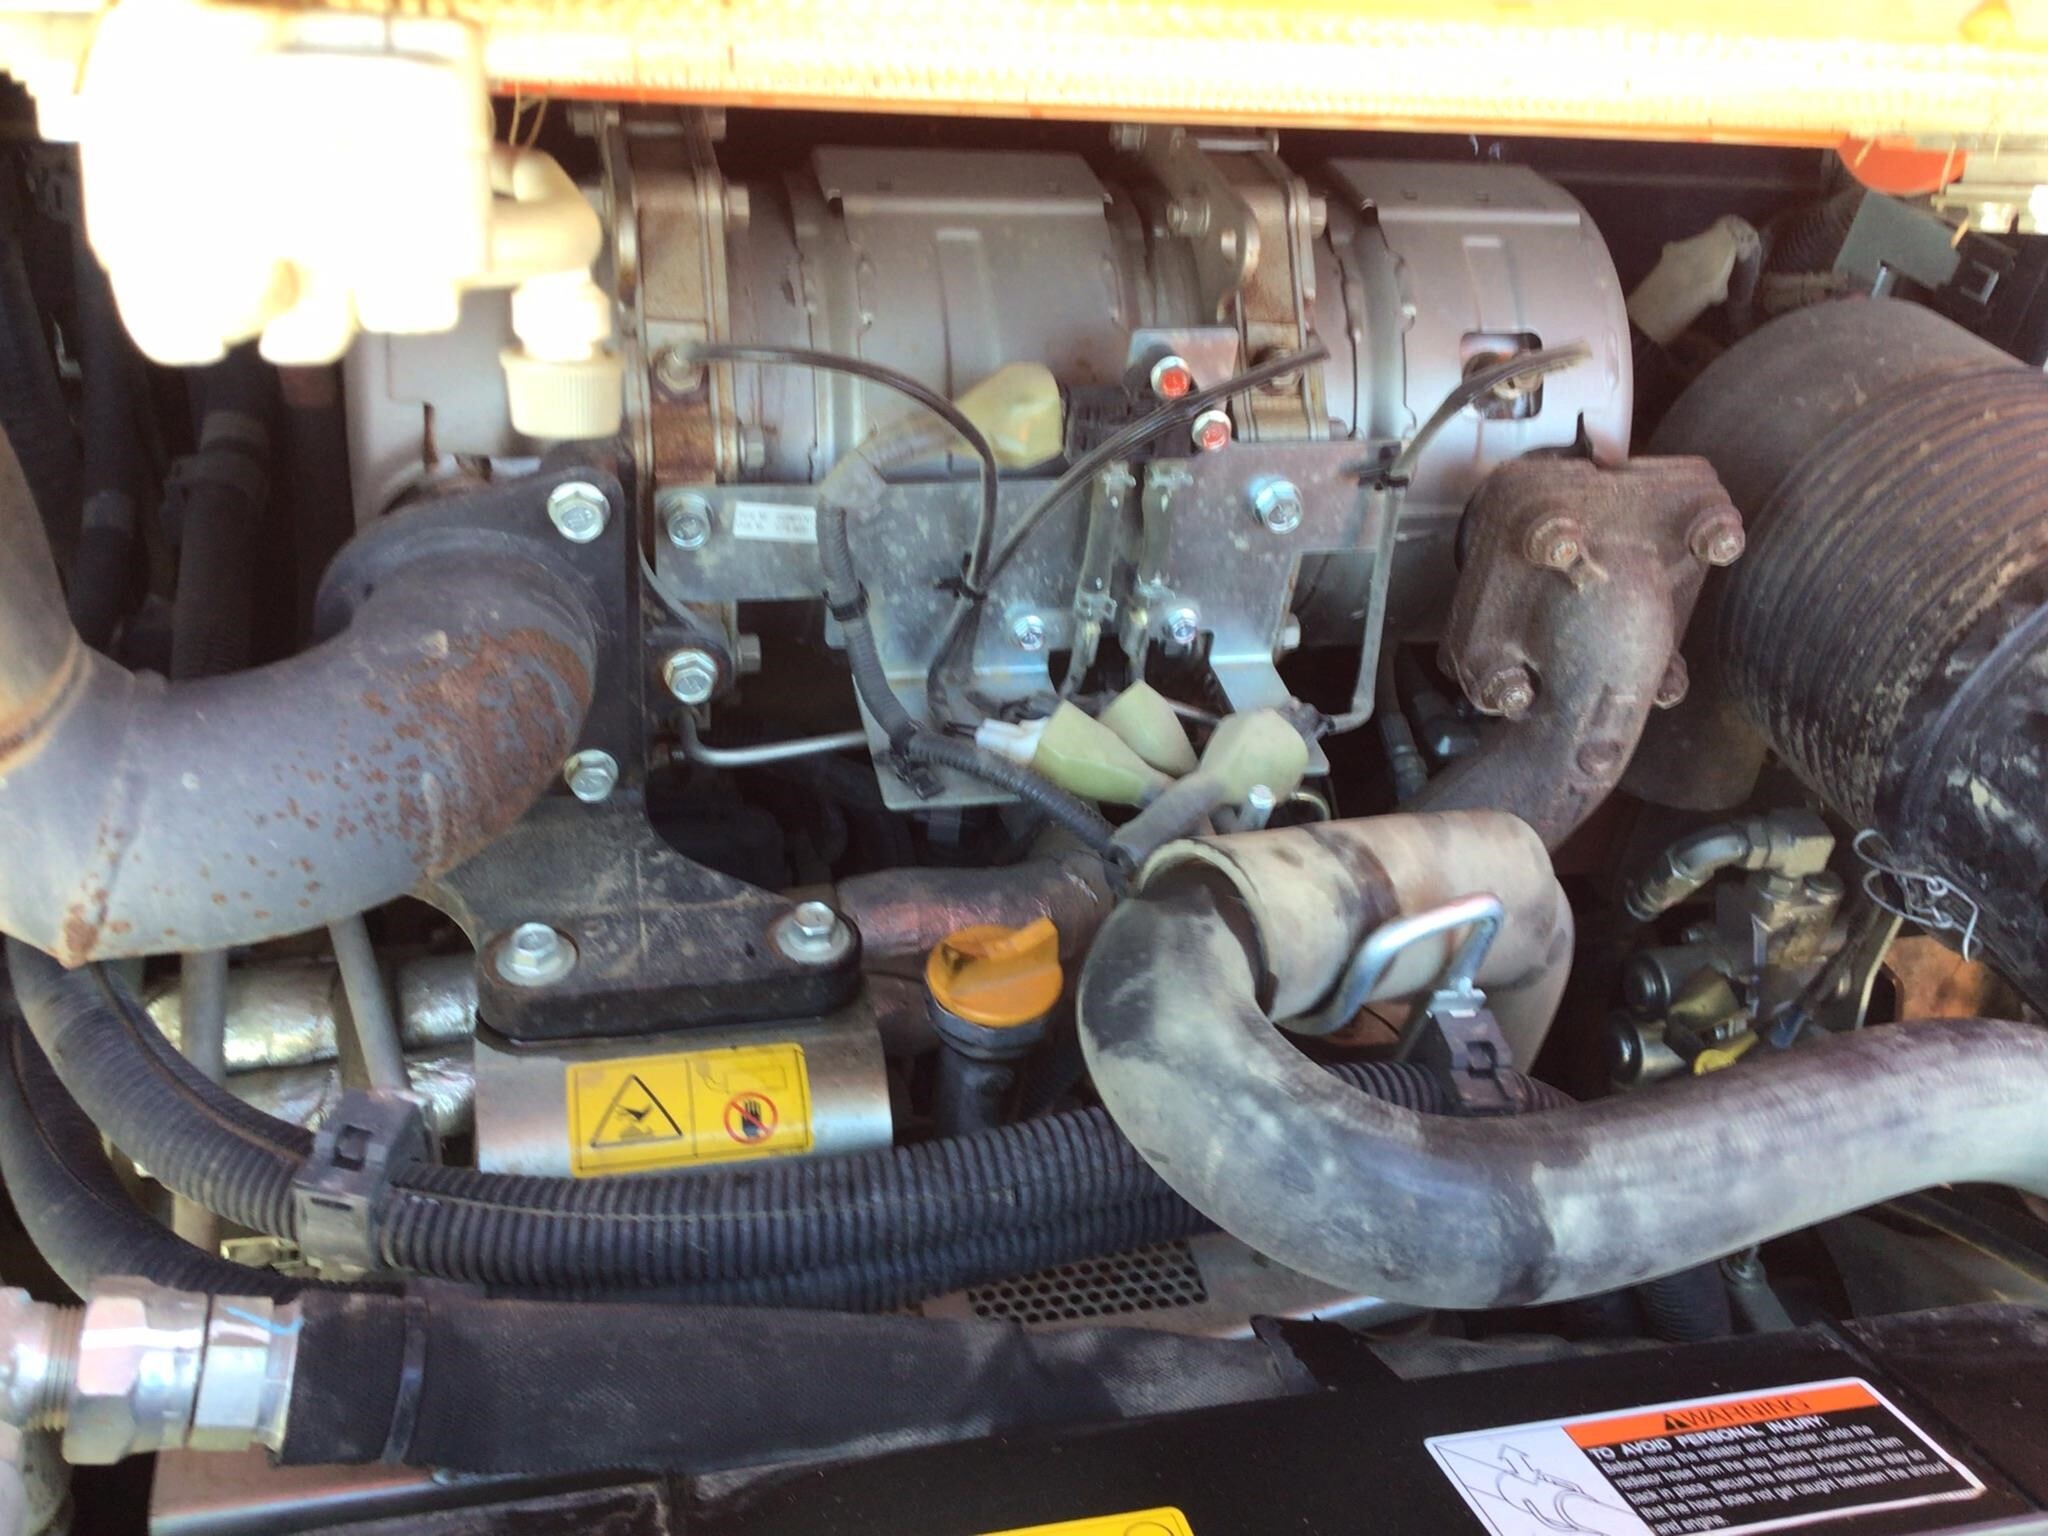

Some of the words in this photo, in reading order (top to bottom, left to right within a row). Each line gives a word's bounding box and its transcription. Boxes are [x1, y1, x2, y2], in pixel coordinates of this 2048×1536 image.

[1680, 1397, 1812, 1426] WARNING
[1588, 1447, 1616, 1461] TO
[1621, 1439, 1673, 1458] AVOID
[1675, 1425, 1766, 1448] PERSONAL
[1675, 1451, 1700, 1464] the
[1698, 1444, 1744, 1460] radiator
[1743, 1439, 1770, 1453] and
[1768, 1437, 1785, 1449] oil
[1822, 1427, 1855, 1440] undo
[1850, 1424, 1876, 1437] the
[1615, 1473, 1664, 1490] radiator
[1661, 1469, 1696, 1482] hose
[1692, 1464, 1725, 1478] from
[1721, 1460, 1746, 1473] the
[1768, 1450, 1813, 1465] Before
[1810, 1441, 1877, 1460] positioning
[1869, 1437, 1905, 1450] them
[1626, 1489, 1662, 1505] back
[1657, 1487, 1676, 1500] in
[1711, 1476, 1756, 1491] secure
[1751, 1472, 1777, 1485] the
[1774, 1465, 1821, 1481] radiator
[1816, 1461, 1849, 1475] hose
[1847, 1457, 1866, 1470] to
[1861, 1455, 1887, 1468] the
[1907, 1450, 1928, 1461] so
[1639, 1504, 1669, 1520] that
[1666, 1502, 1691, 1516] the
[1687, 1498, 1723, 1513] hose
[1721, 1493, 1756, 1507] does
[1753, 1488, 1778, 1502] not
[1774, 1484, 1799, 1501] get
[1796, 1476, 1840, 1495] caught
[1835, 1470, 1890, 1489] between
[1885, 1468, 1911, 1481] the
[1907, 1460, 1950, 1478] shroud
[1655, 1519, 1686, 1536] and
